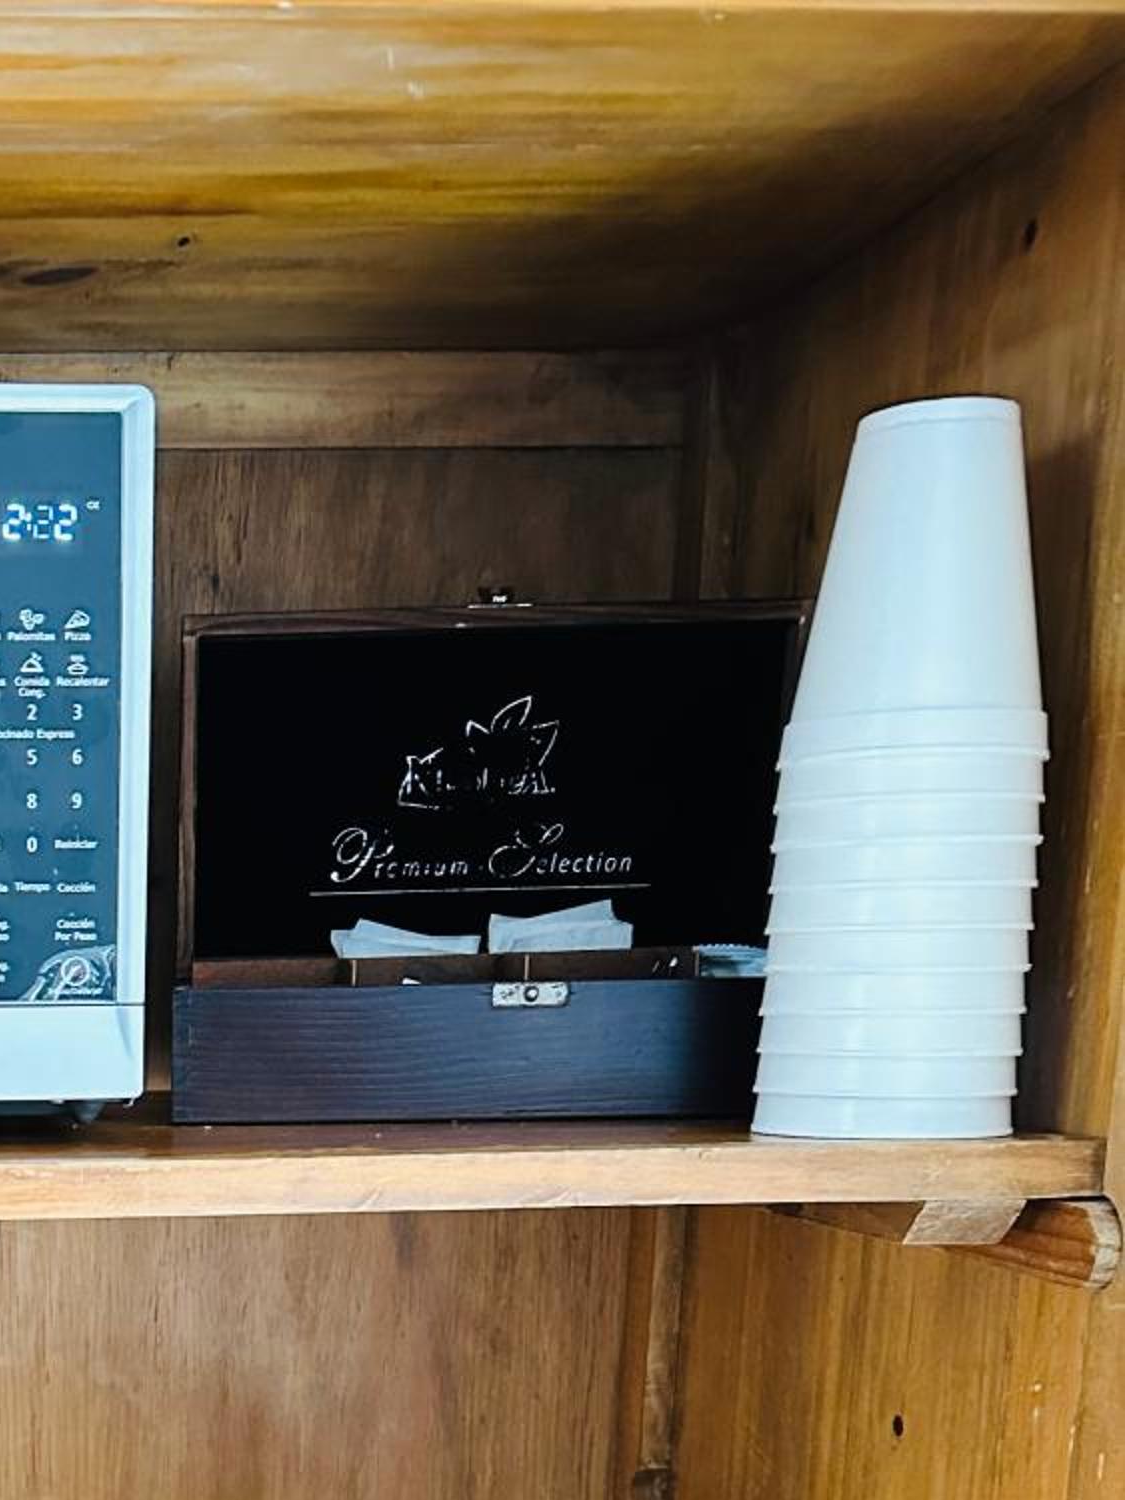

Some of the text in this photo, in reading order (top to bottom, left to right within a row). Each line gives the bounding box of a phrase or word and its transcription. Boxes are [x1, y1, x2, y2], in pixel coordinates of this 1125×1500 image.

[14, 676, 50, 687] Comida
[56, 676, 109, 686] Recalentar
[27, 703, 37, 721] 2
[72, 703, 83, 721] 3
[26, 748, 38, 766] 5
[72, 748, 83, 765] 6
[26, 793, 38, 809] 8
[71, 792, 82, 809] 9
[26, 836, 38, 853] 0
